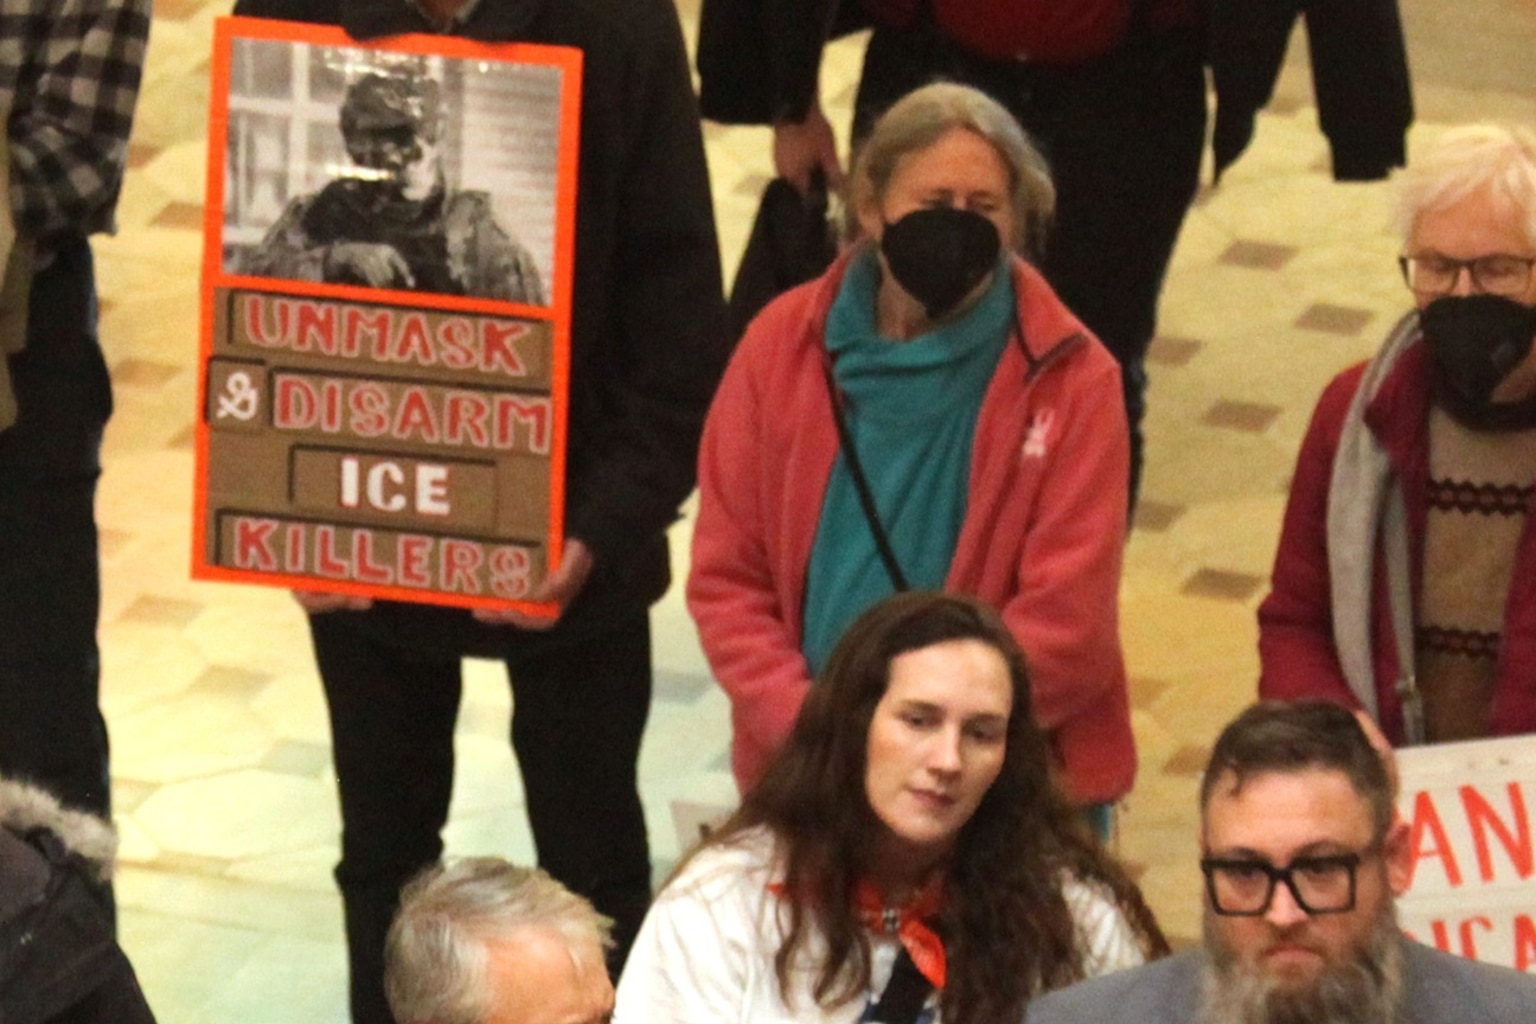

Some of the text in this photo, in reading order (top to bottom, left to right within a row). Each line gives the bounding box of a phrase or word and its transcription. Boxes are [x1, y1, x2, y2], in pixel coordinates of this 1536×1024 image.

[244, 297, 530, 377] UNMASK
[216, 371, 551, 454] & DISARM
[340, 456, 452, 516] ICE
[233, 518, 532, 600] KILLERS
